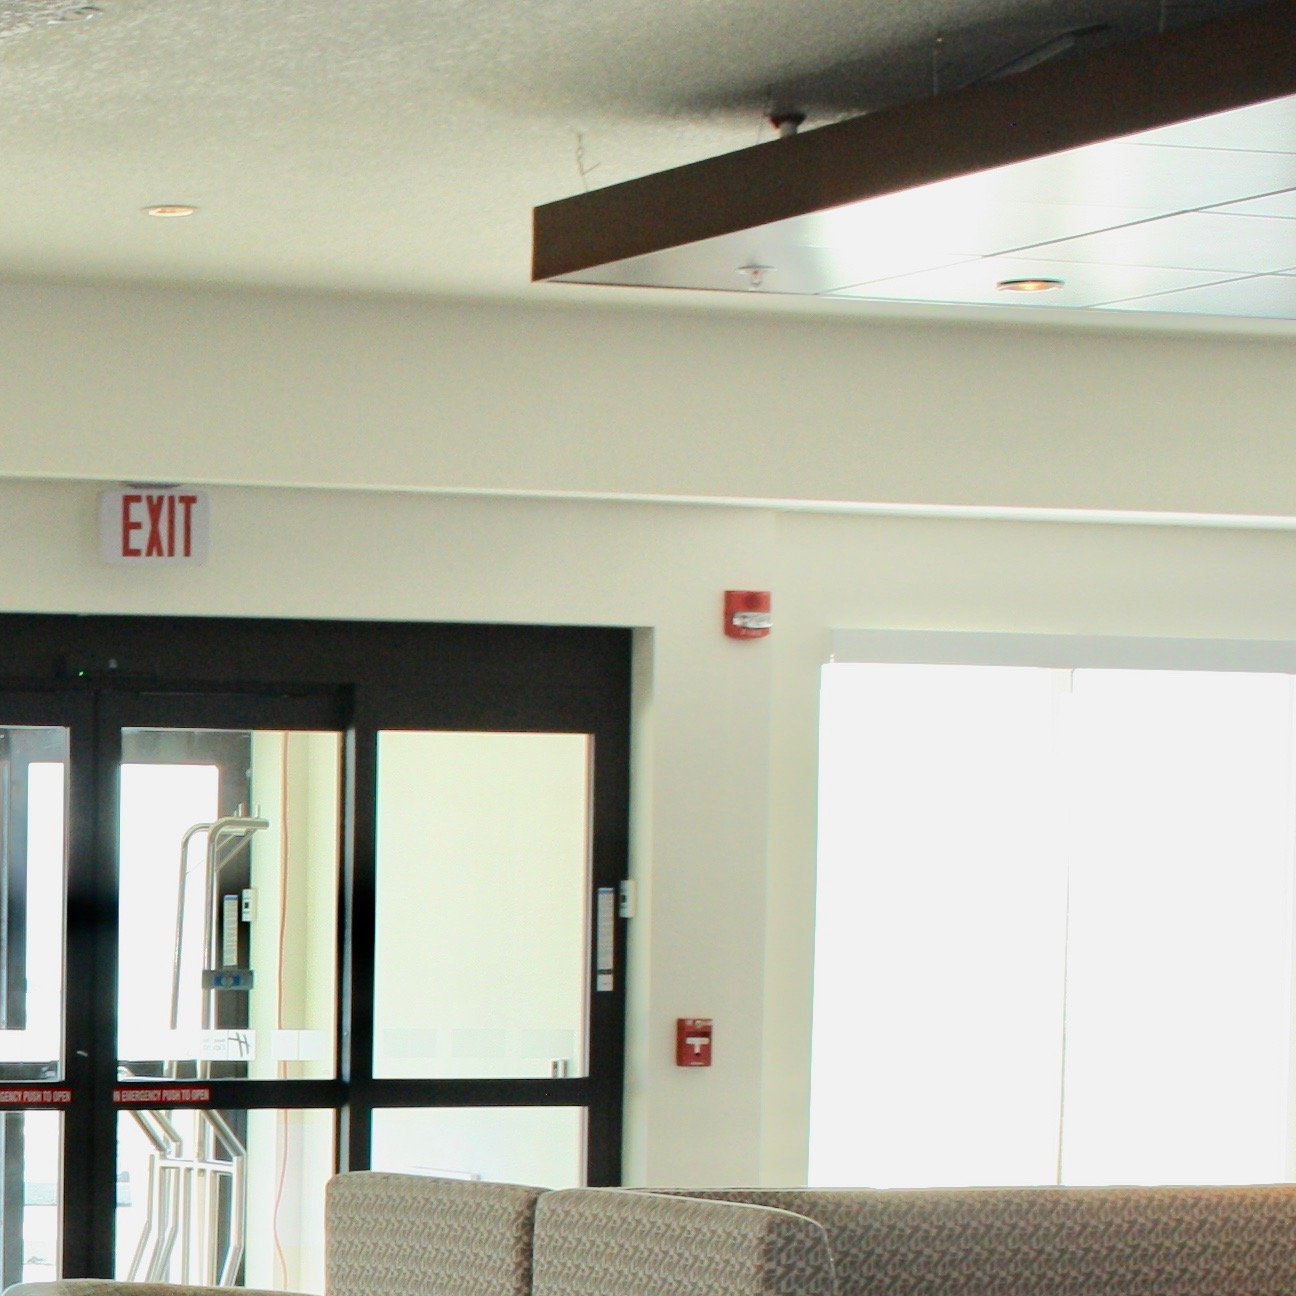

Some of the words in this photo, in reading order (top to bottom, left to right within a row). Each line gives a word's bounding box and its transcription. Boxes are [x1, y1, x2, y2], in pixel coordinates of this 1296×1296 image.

[122, 495, 198, 557] EXIT
[22, 1090, 42, 1102] PUSH
[42, 1090, 53, 1102] TO
[53, 1090, 72, 1102] OPEN
[121, 1090, 162, 1102] EMERGENCY
[162, 1089, 181, 1101] PUSH
[181, 1089, 191, 1101] TO
[191, 1088, 210, 1101] OPEN
